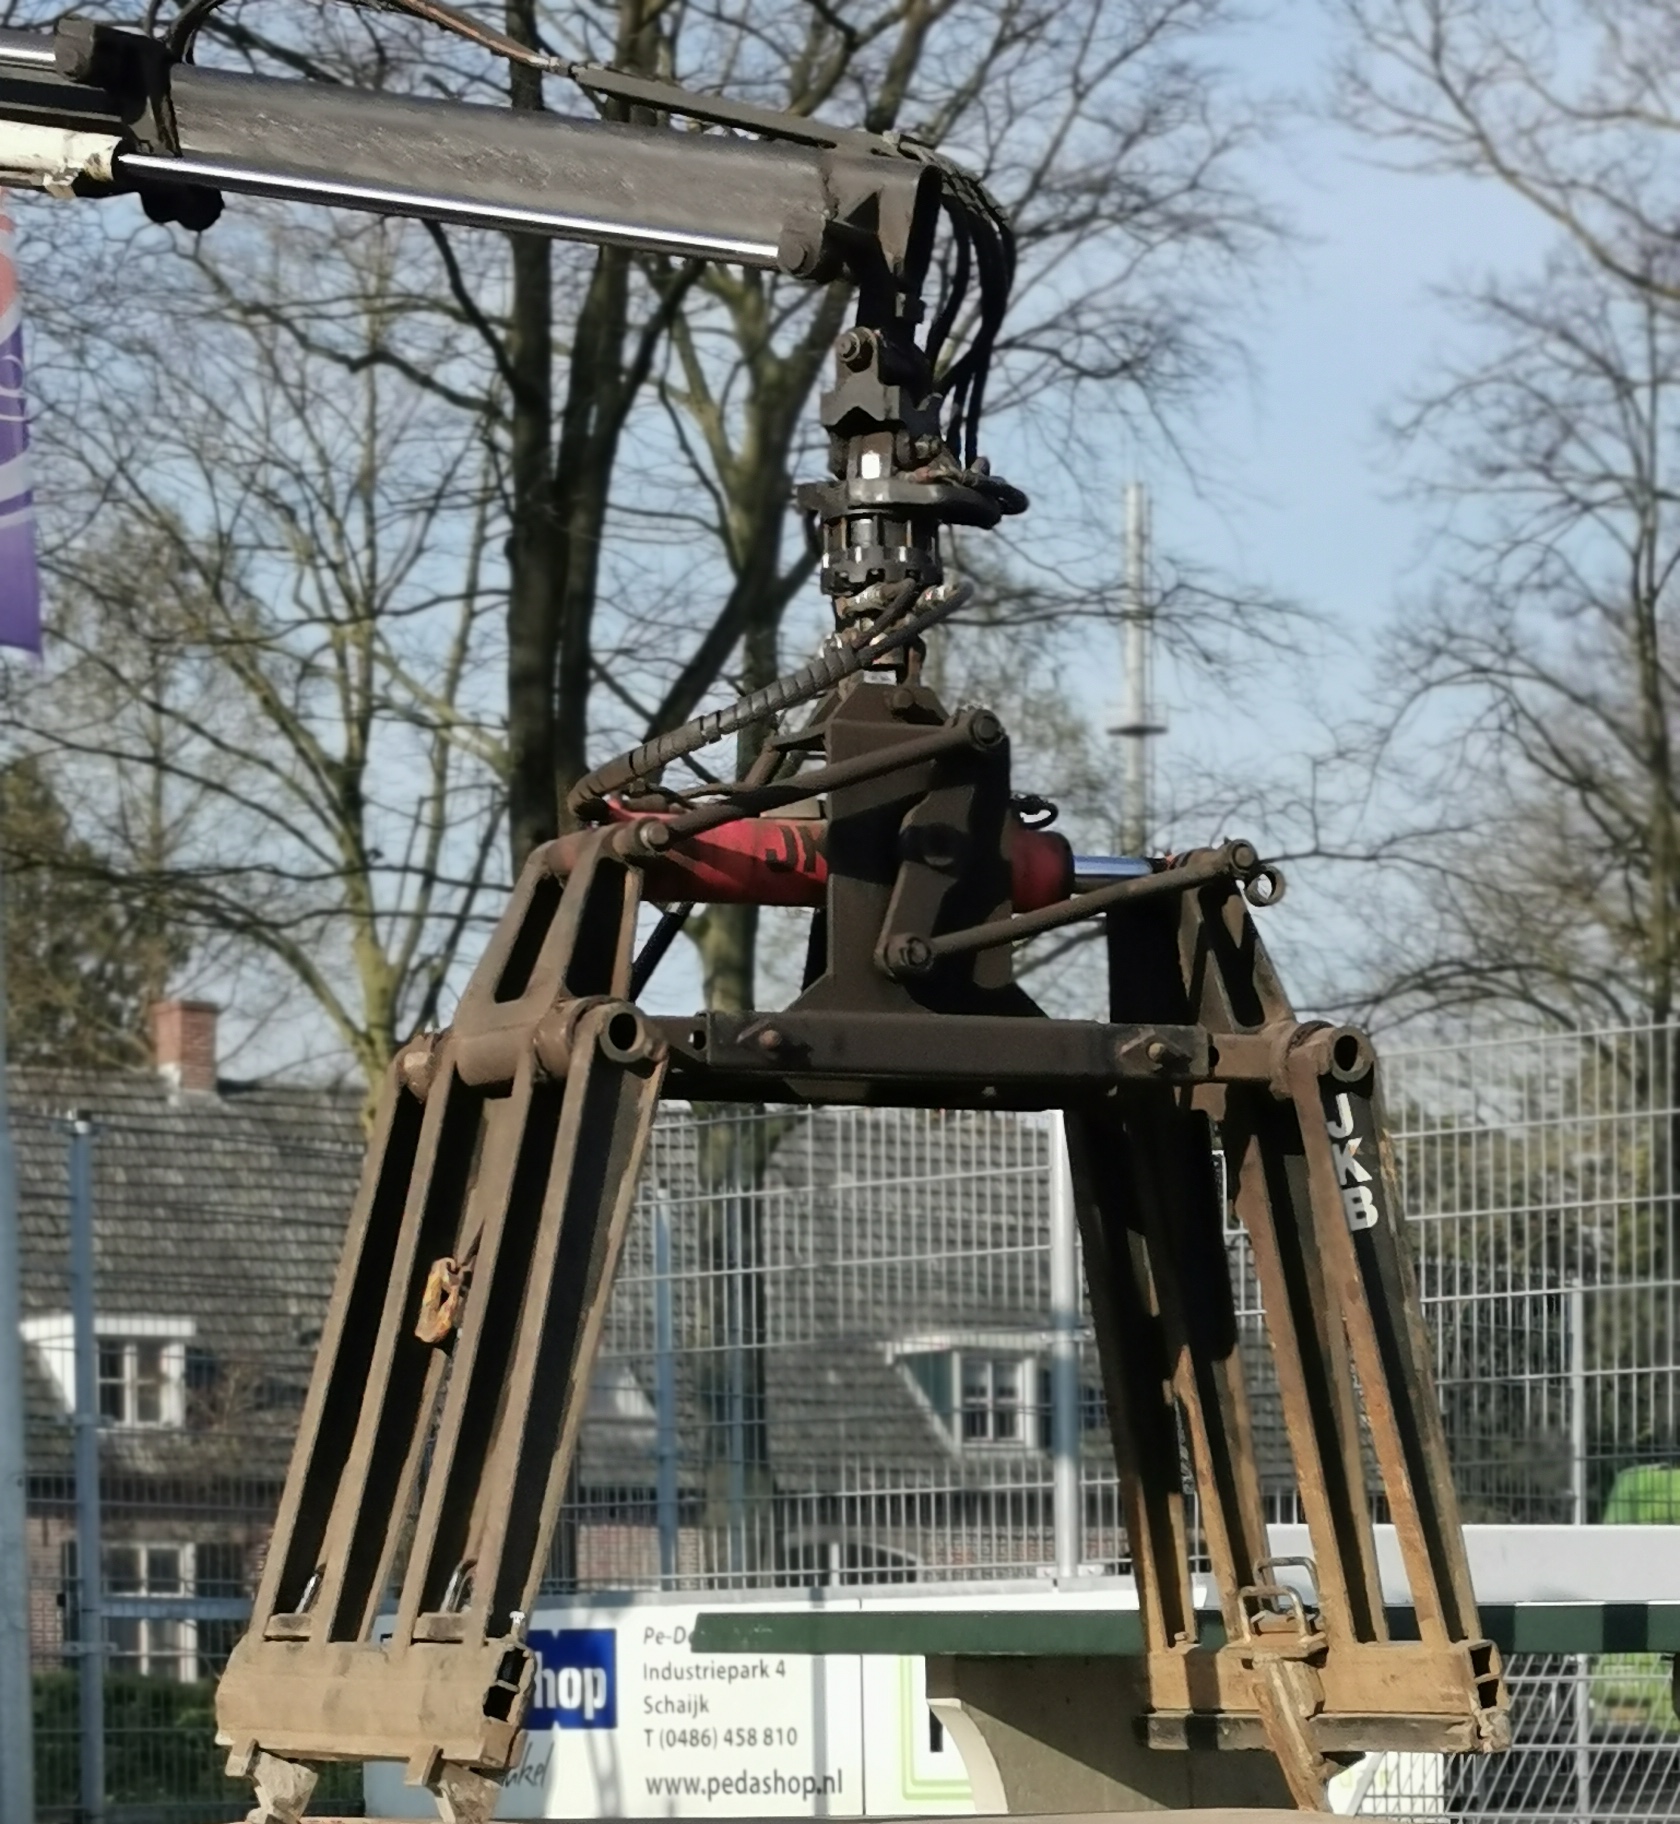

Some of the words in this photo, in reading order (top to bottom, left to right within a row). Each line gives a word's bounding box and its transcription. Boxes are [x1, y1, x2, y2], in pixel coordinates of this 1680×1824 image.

[765, 825, 828, 873] JK
[1327, 1092, 1379, 1232] JKB
[643, 1625, 693, 1646] Pe-D
[533, 1650, 608, 1721] hop
[643, 1659, 770, 1685] Industriepark
[775, 1659, 787, 1678] 4
[643, 1694, 710, 1719] Schaijk
[643, 1728, 655, 1748] T
[659, 1727, 718, 1750] (0486)
[723, 1727, 758, 1748] 458
[762, 1727, 798, 1747] 810
[644, 1768, 843, 1802] www.pedashop.nl
